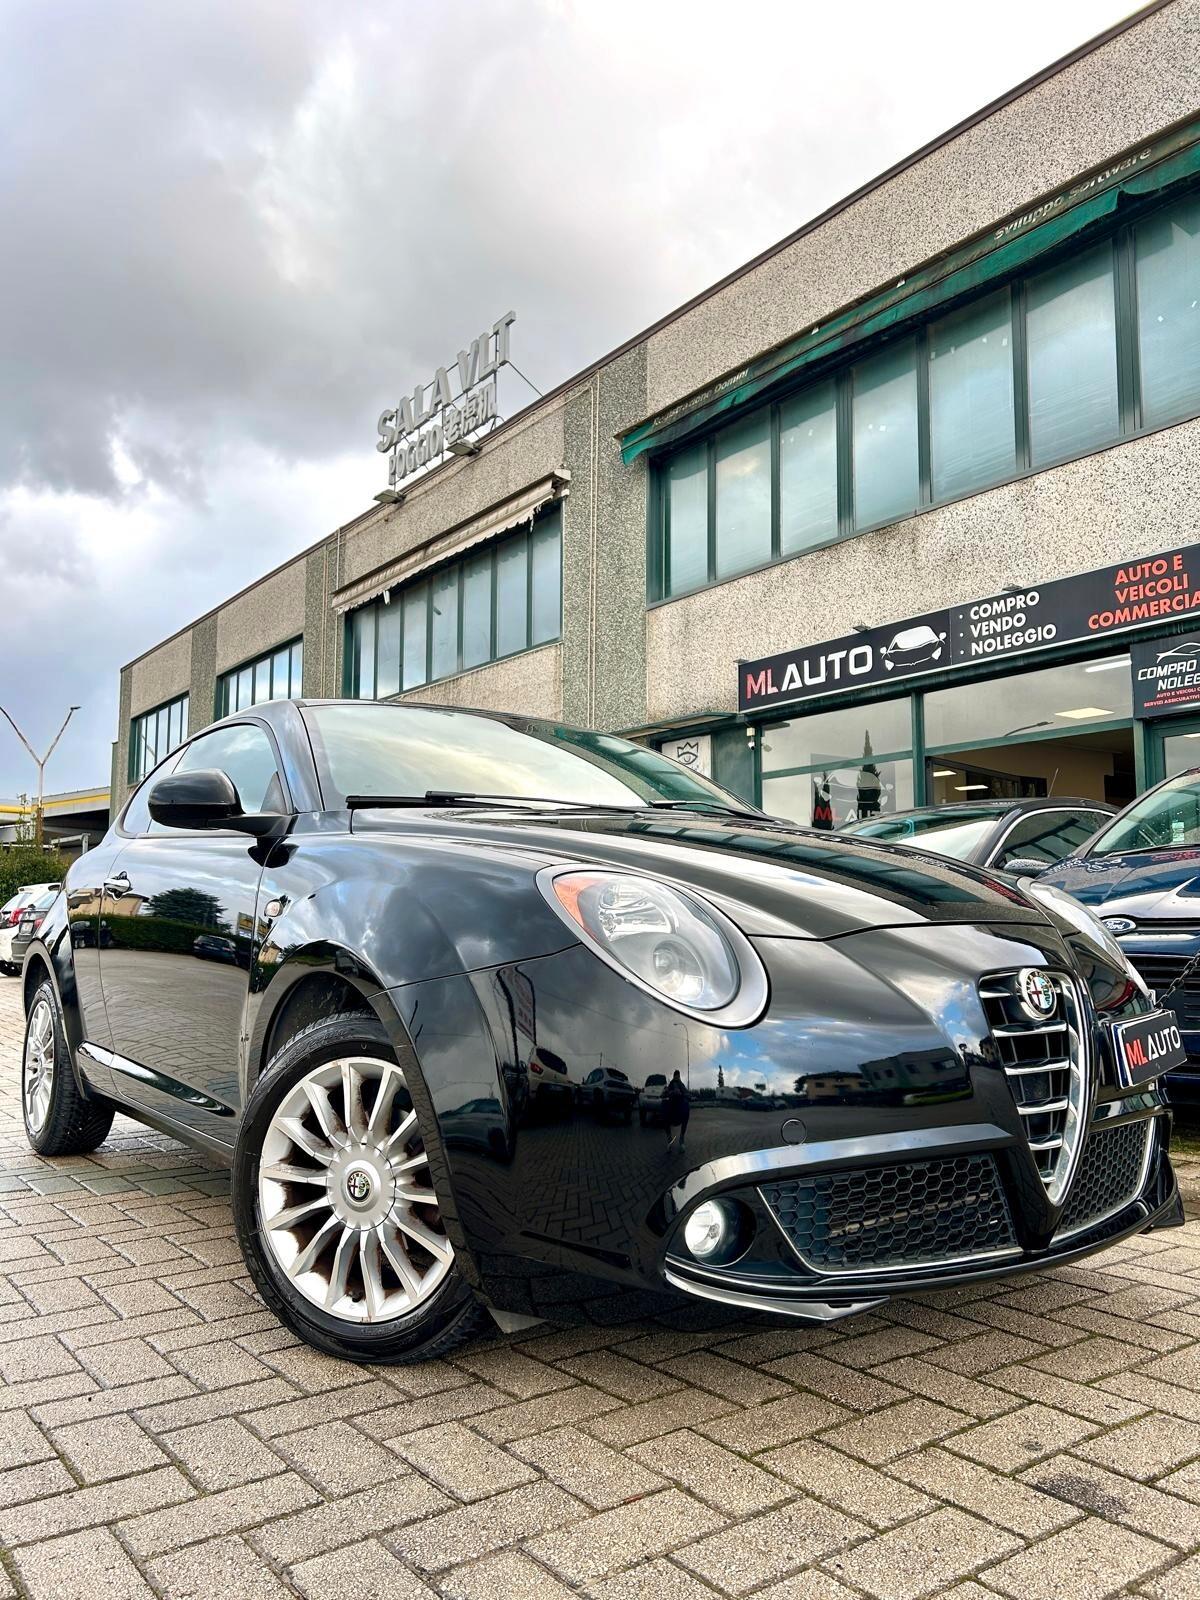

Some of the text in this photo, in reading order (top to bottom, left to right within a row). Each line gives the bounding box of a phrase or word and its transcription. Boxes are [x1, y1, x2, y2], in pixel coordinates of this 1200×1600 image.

[376, 310, 517, 454] SALA VLT
[388, 424, 445, 486] POGGIO
[1114, 554, 1184, 586] AUTO E
[1114, 573, 1189, 604] VEICOLI
[970, 591, 1040, 620] COMPRO
[970, 612, 1026, 638] VENDO
[970, 623, 1057, 656] NOLEGGIO
[1137, 659, 1197, 681] COMPRO
